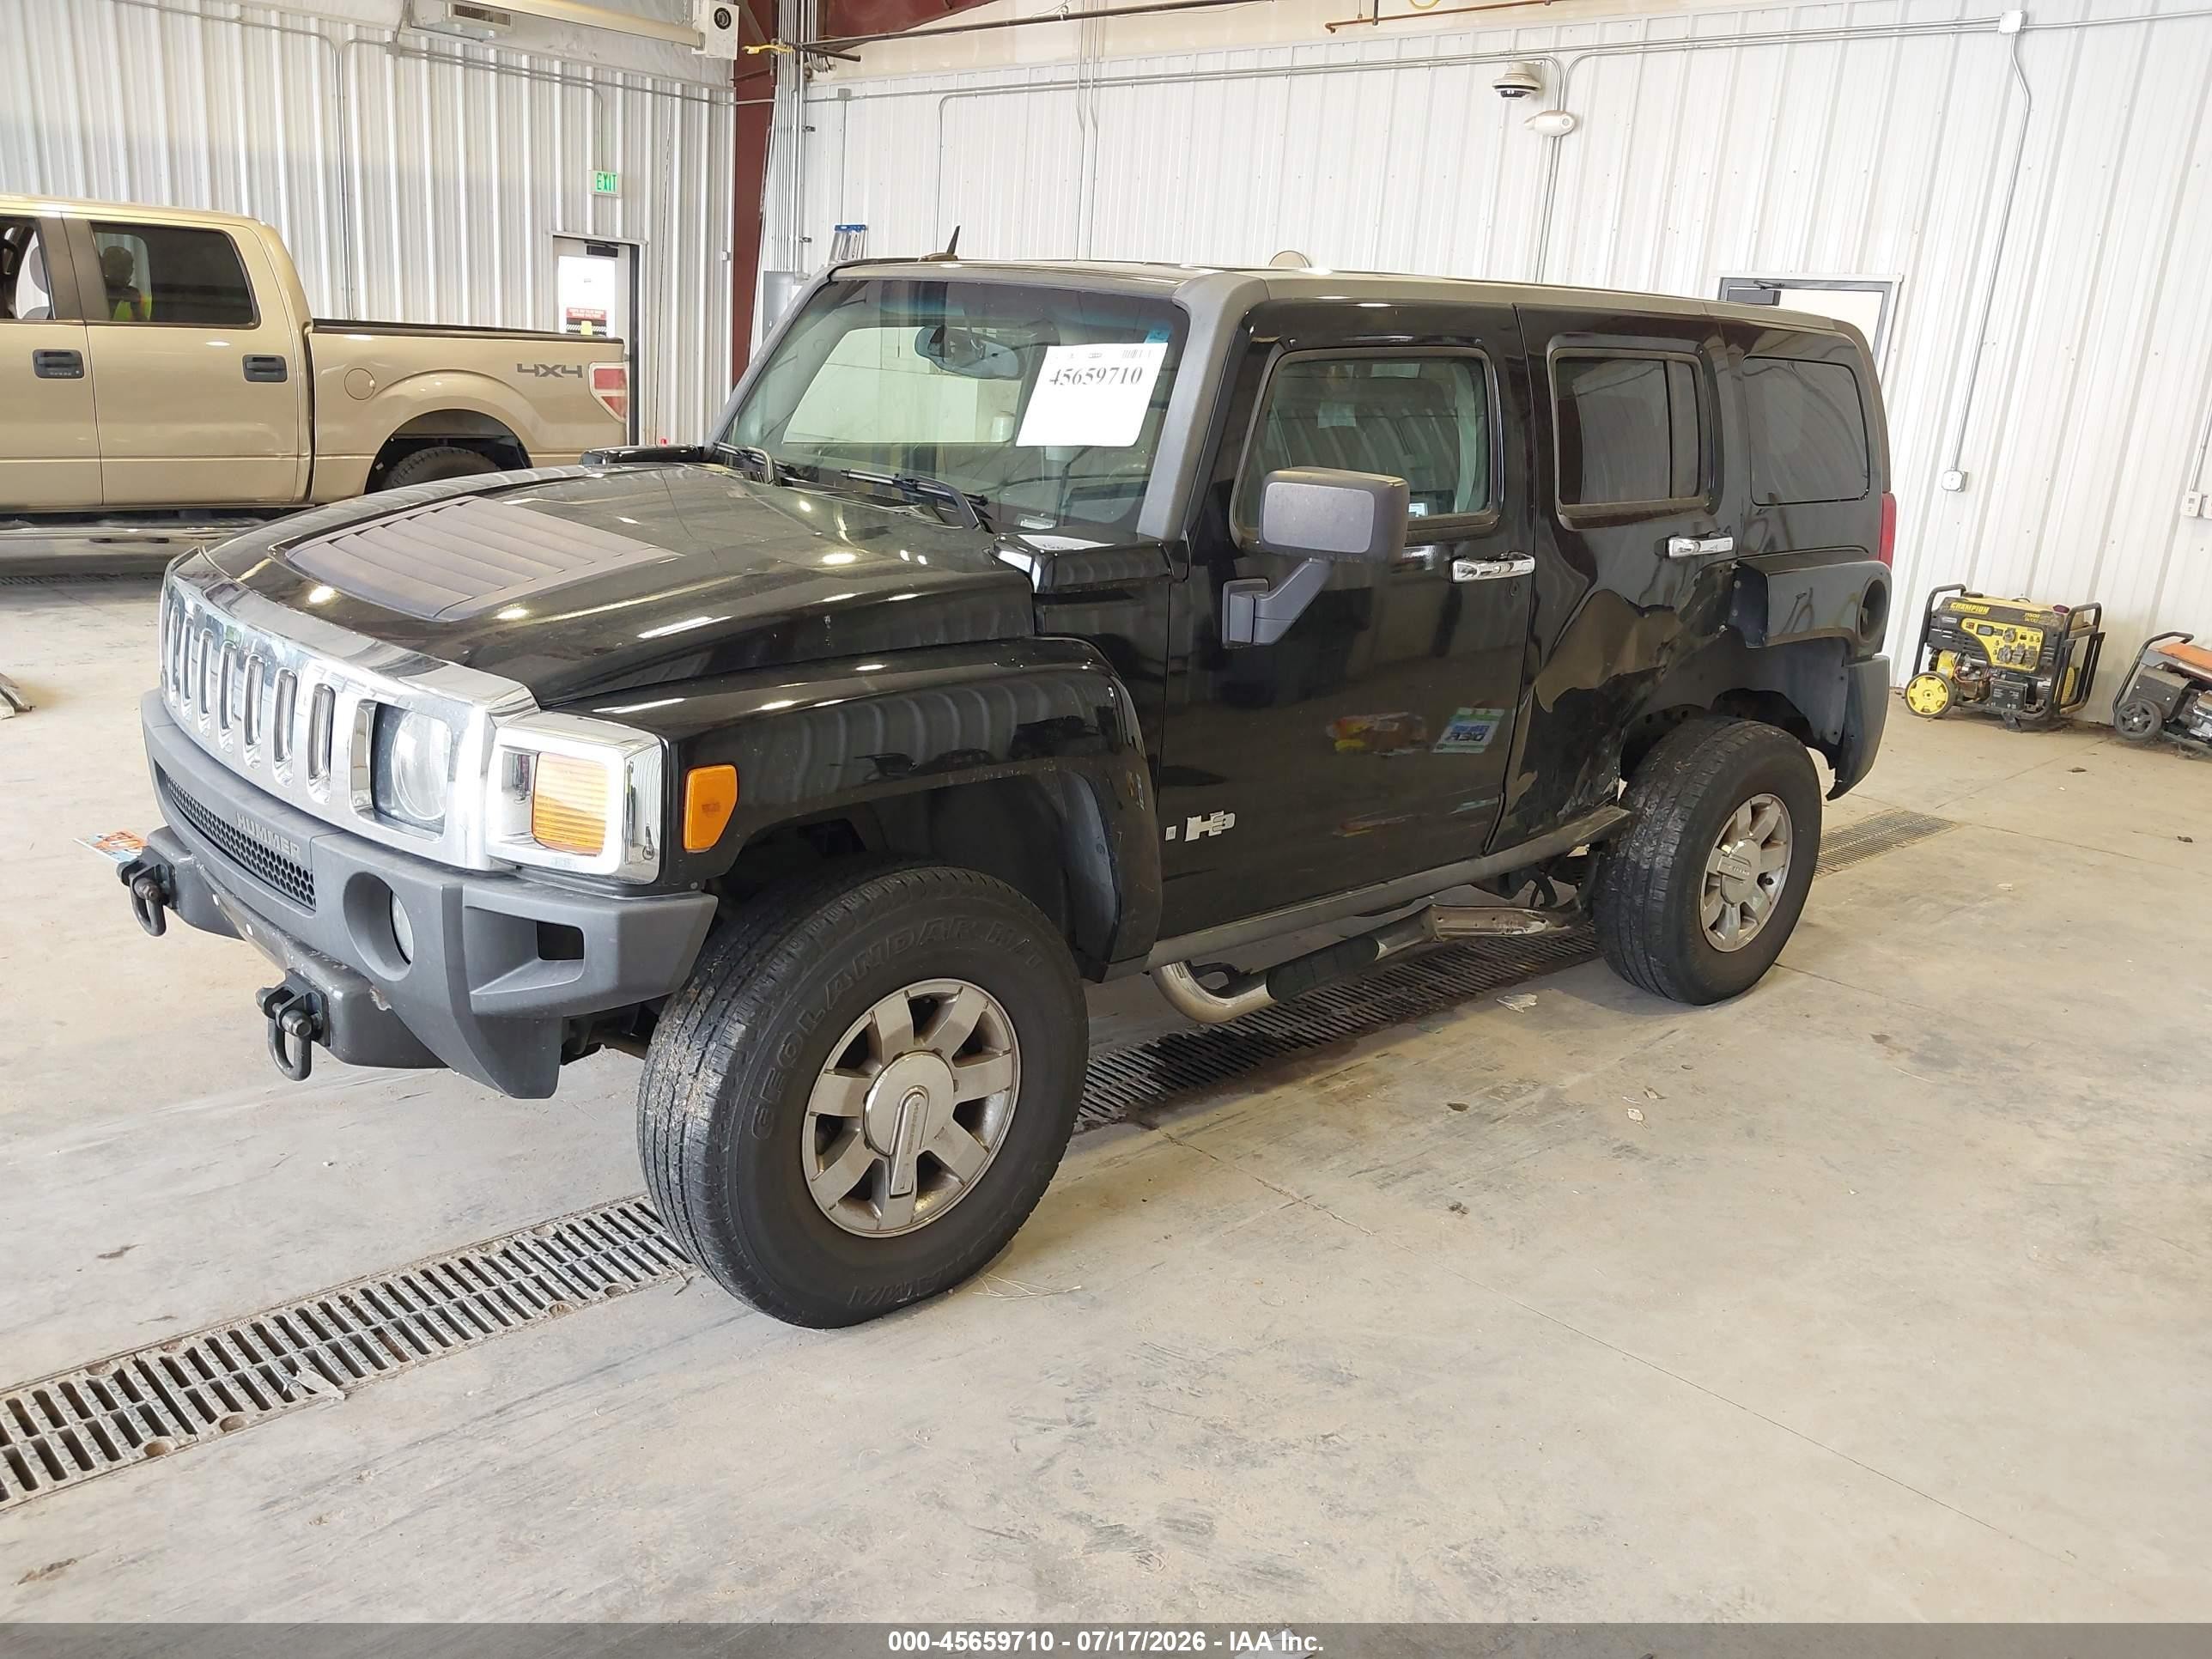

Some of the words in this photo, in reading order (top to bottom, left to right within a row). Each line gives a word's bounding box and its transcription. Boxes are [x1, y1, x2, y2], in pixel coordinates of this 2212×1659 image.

[596, 172, 617, 192] EXIT
[1049, 366, 1144, 386] 45659710
[1950, 602, 1990, 615] CHAMPION
[235, 811, 301, 860] HUMMER
[1184, 810, 1236, 842] H3
[750, 915, 977, 1141] GEOLANDAR
